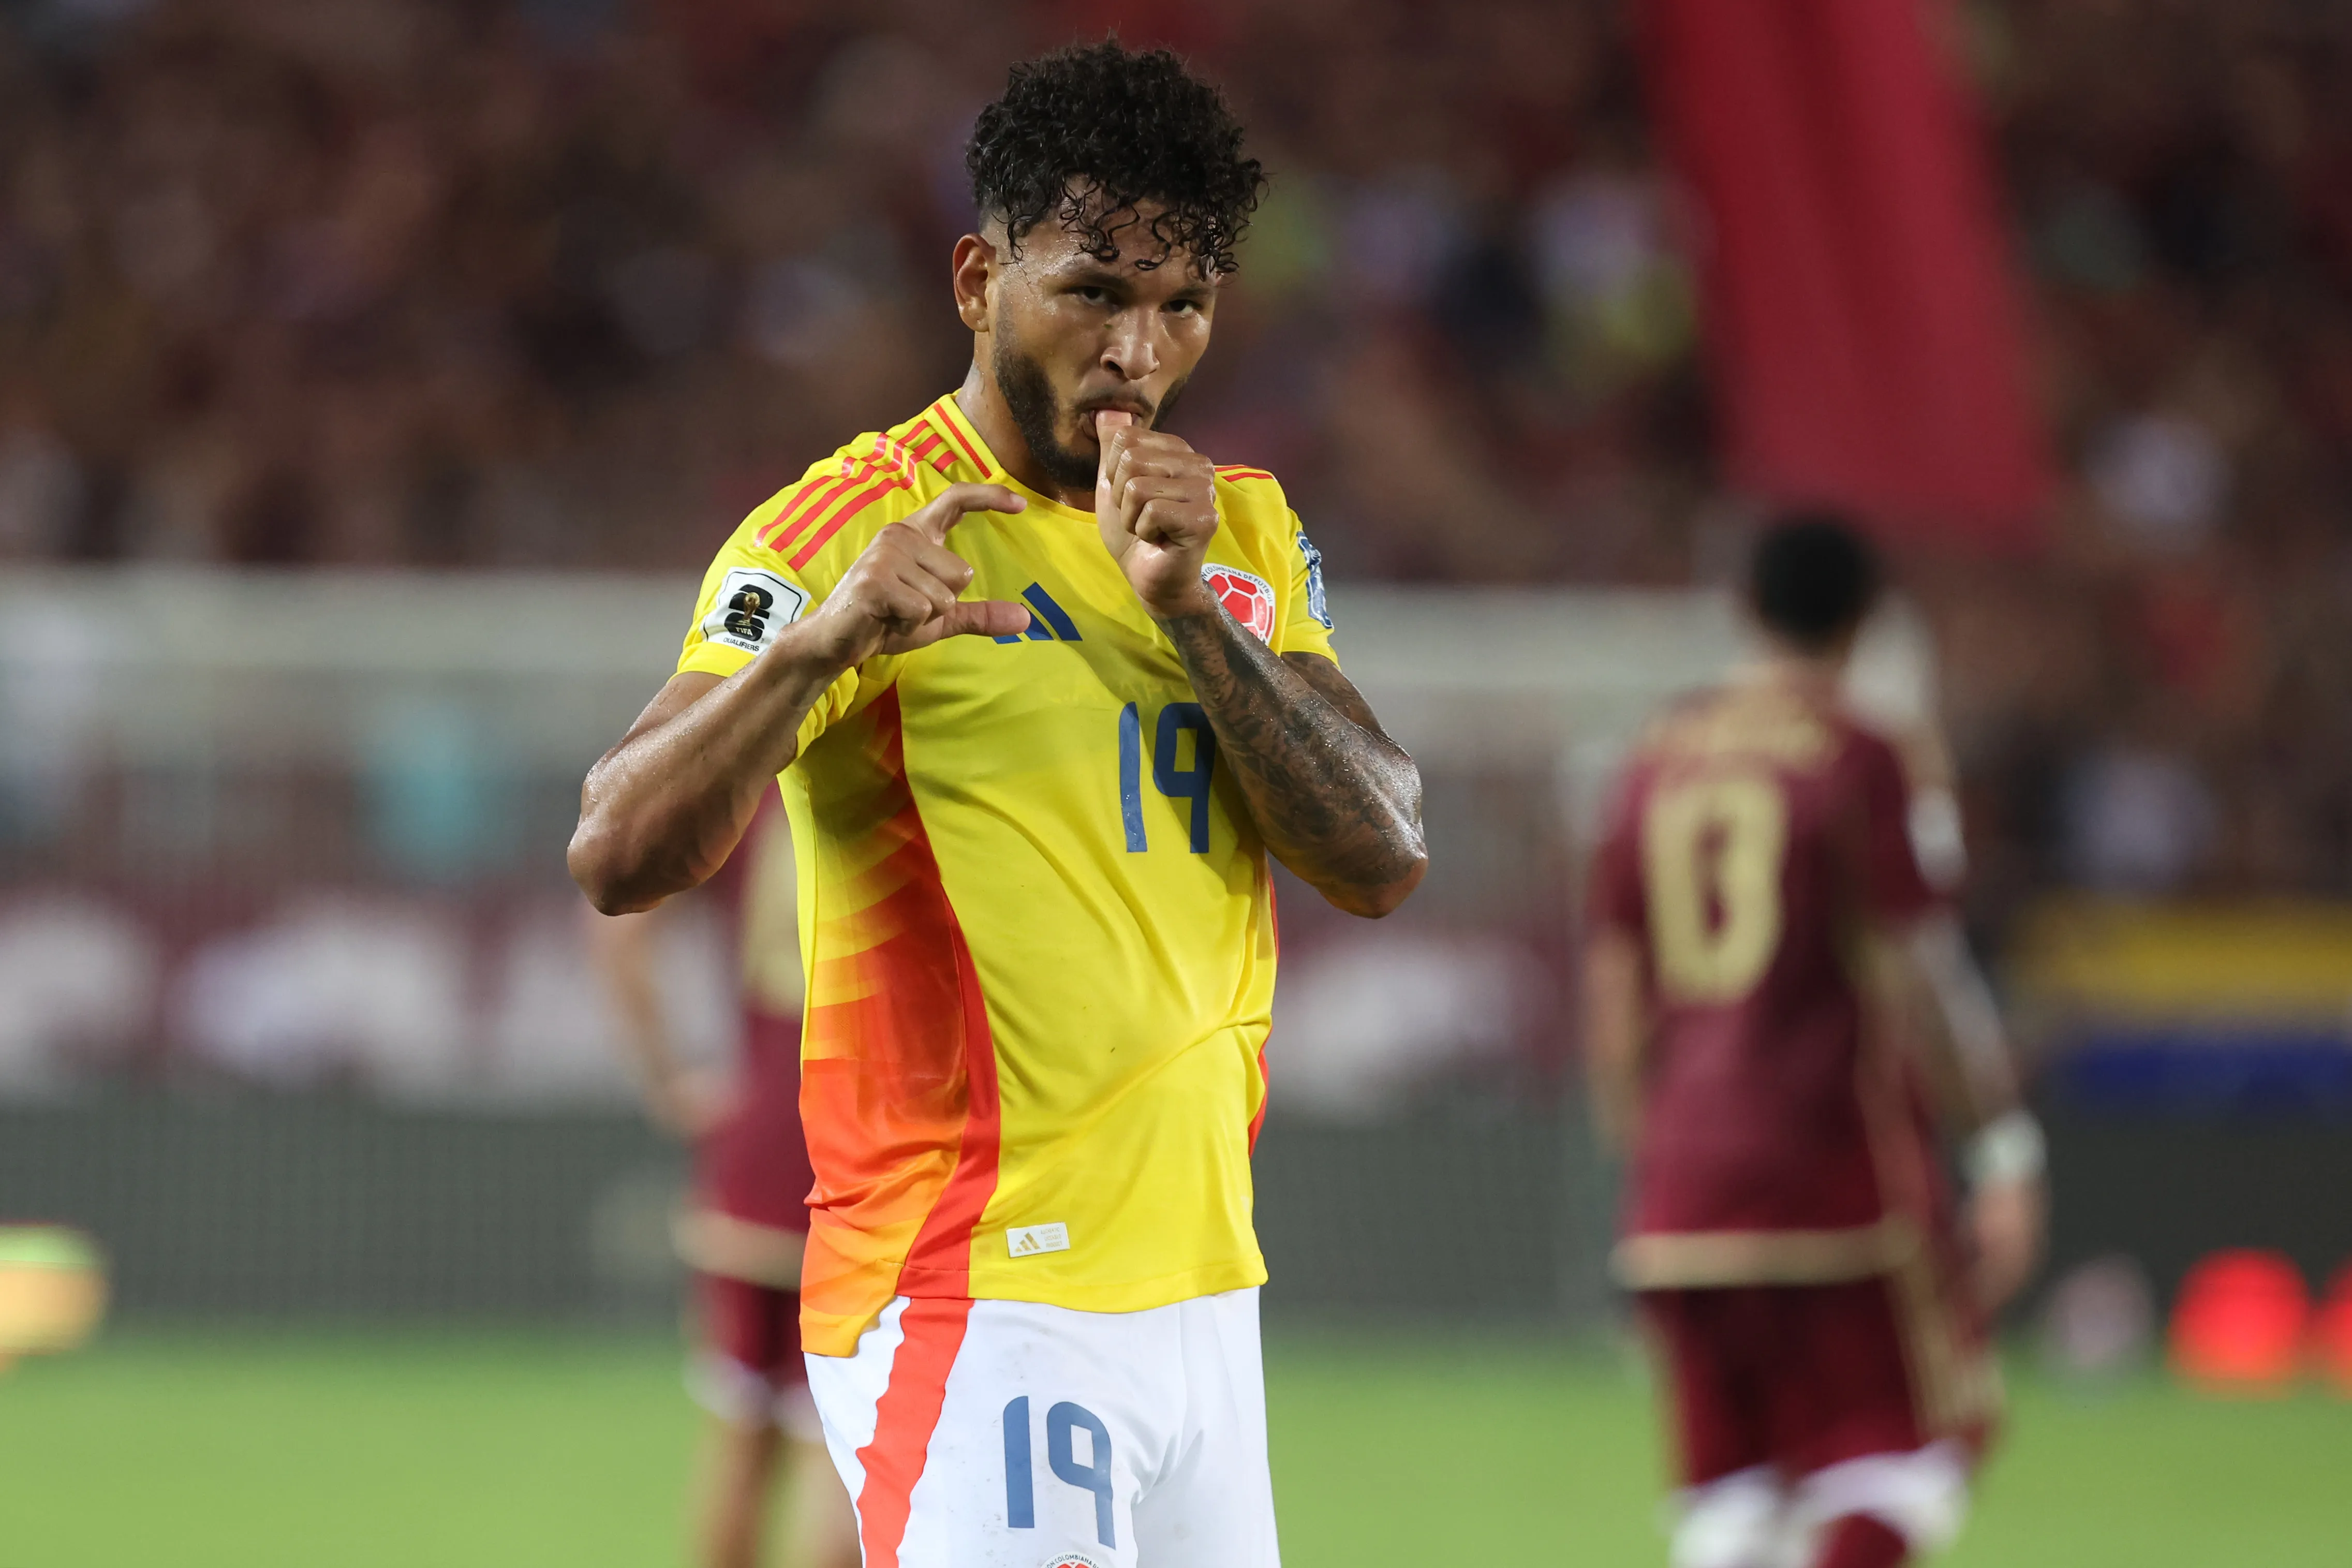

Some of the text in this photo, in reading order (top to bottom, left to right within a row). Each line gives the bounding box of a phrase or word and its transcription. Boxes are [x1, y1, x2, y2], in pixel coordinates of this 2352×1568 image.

[1205, 565, 1241, 576] COLOMBIANA
[735, 627, 753, 636] FIFA
[723, 637, 760, 652] QUALIFIERS
[1119, 701, 1217, 853] 19
[1003, 1395, 1116, 1550] 19
[1055, 1554, 1092, 1565] COLOMBIANA
